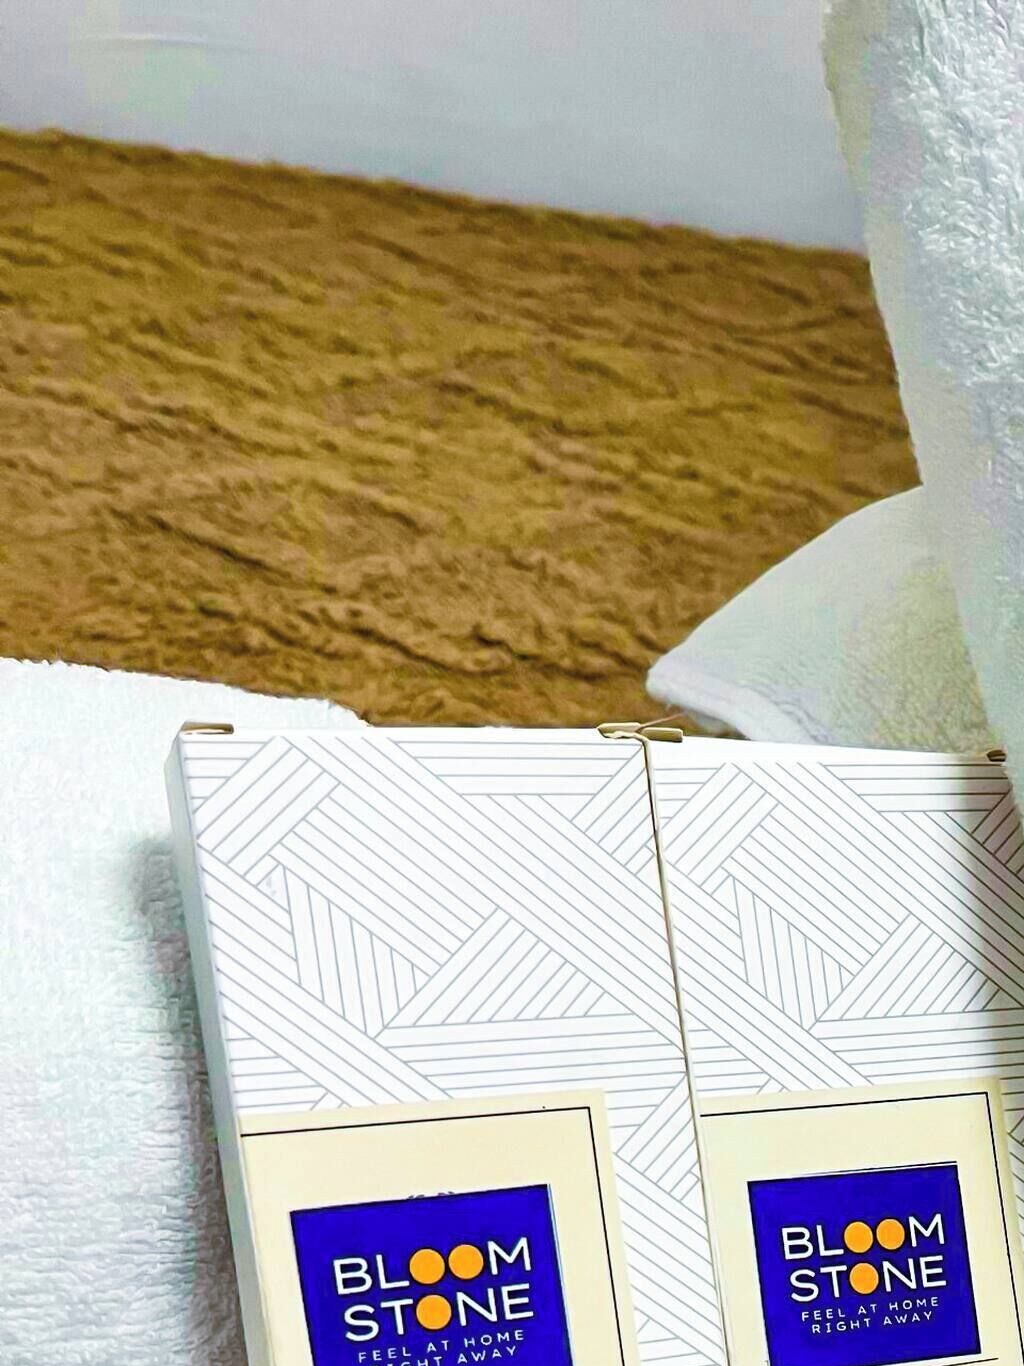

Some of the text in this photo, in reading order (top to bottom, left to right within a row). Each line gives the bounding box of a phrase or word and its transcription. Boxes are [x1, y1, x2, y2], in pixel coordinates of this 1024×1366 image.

[782, 1213, 945, 1260] BLOOM
[333, 1237, 532, 1295] BLOOM
[790, 1255, 947, 1302] STONE
[344, 1283, 534, 1342] STONE
[801, 1297, 939, 1322] FEEL AT HOME
[812, 1311, 933, 1334] RIGHT AWAY
[358, 1330, 525, 1363] FEEL AT HOME
[457, 1345, 518, 1364] AWAY
